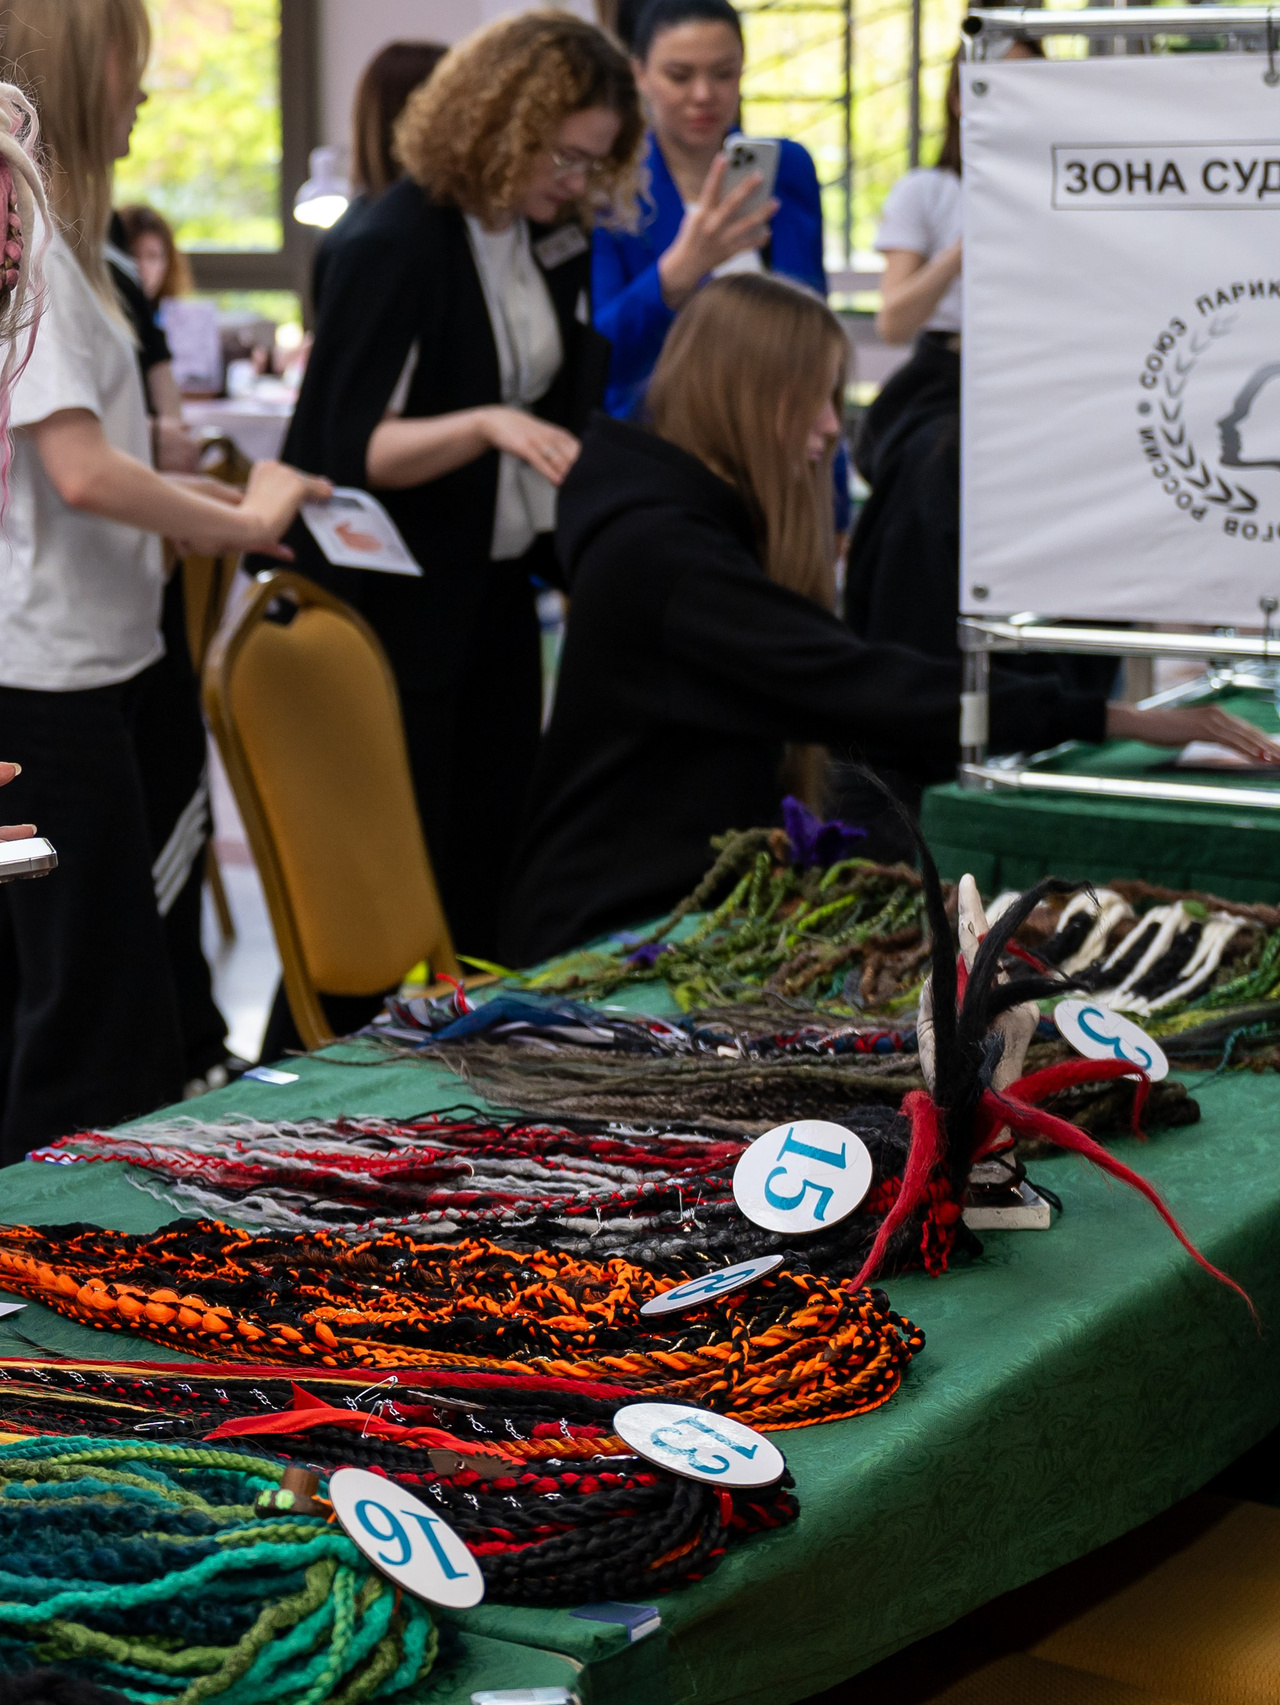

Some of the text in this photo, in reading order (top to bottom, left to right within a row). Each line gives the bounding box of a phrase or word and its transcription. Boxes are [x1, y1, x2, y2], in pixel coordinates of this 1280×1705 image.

[1065, 160, 1187, 194] ЗОНА
[1138, 316, 1188, 389] СОЮЗ
[1138, 426, 1209, 522] РОССИИ
[764, 1126, 847, 1222] 15
[667, 1268, 756, 1300] 8
[650, 1415, 759, 1475] 13
[354, 1499, 469, 1581] 16
